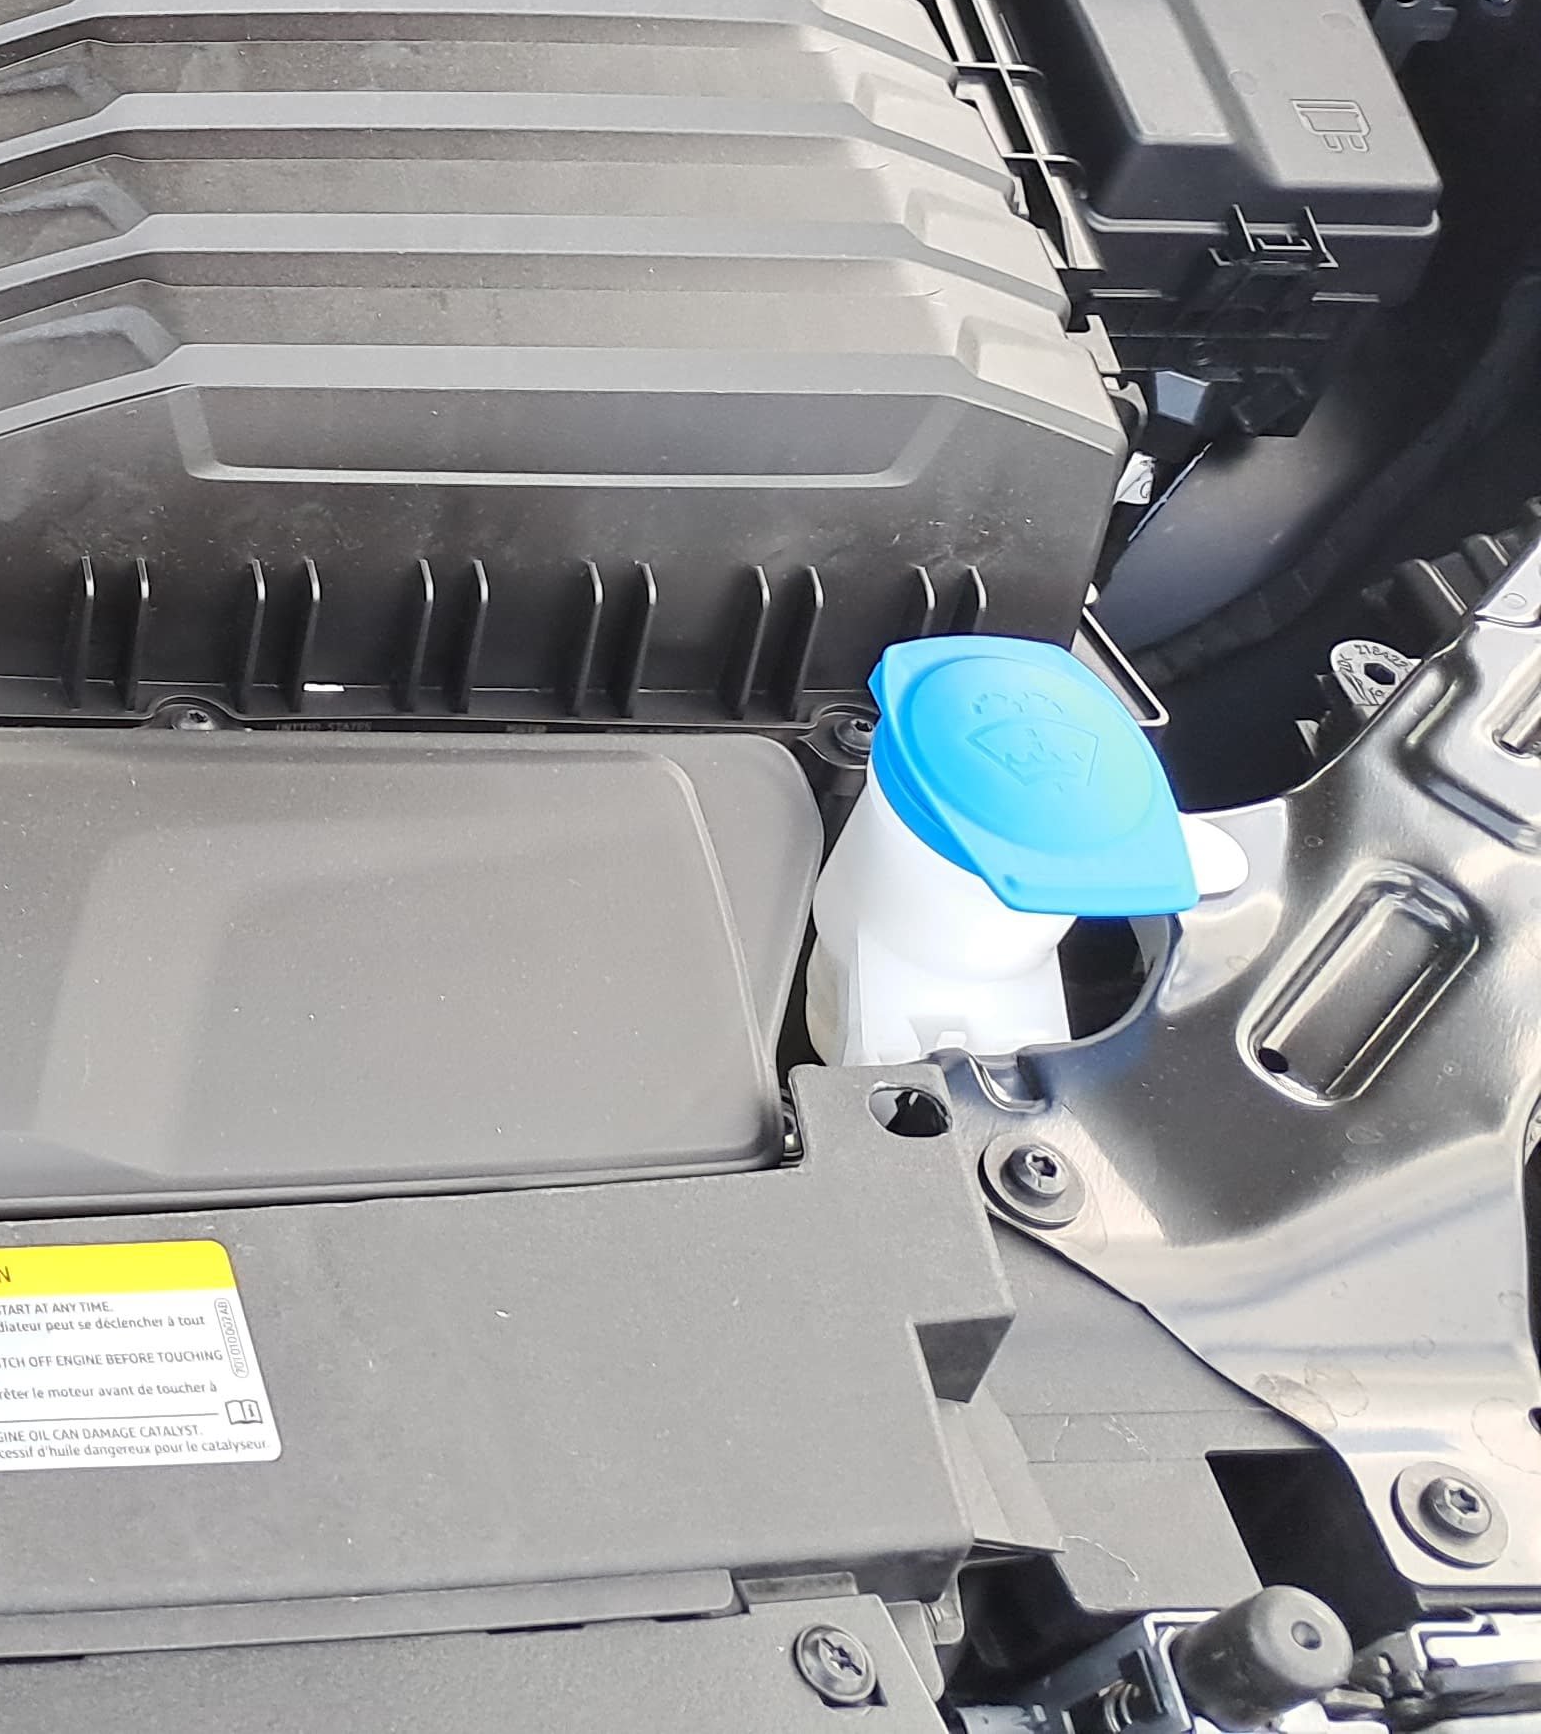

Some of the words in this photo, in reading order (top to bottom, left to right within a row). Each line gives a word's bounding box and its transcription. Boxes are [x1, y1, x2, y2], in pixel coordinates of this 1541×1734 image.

[35, 1303, 48, 1314] AT
[53, 1303, 76, 1313] ANY
[79, 1301, 113, 1312] TIME.
[45, 1321, 74, 1333] peut
[95, 1317, 163, 1329] déclencher
[178, 1316, 205, 1326] tout
[28, 1356, 52, 1367] OFF
[56, 1354, 102, 1366] ENGINE
[105, 1352, 154, 1365] BEFORE
[157, 1350, 223, 1363] TOUCHING
[32, 1387, 44, 1399] le
[48, 1388, 93, 1398] moteur
[98, 1386, 134, 1397] avant
[156, 1382, 205, 1394] toucher
[29, 1430, 50, 1442] OIL
[52, 1429, 79, 1440] CAN
[82, 1427, 136, 1439] DAMAGE
[139, 1425, 202, 1438] CATALYST.
[37, 1444, 80, 1457] d'huile
[84, 1444, 151, 1458] dangereux
[154, 1444, 182, 1456] pour
[201, 1440, 269, 1453] catalyseur.
